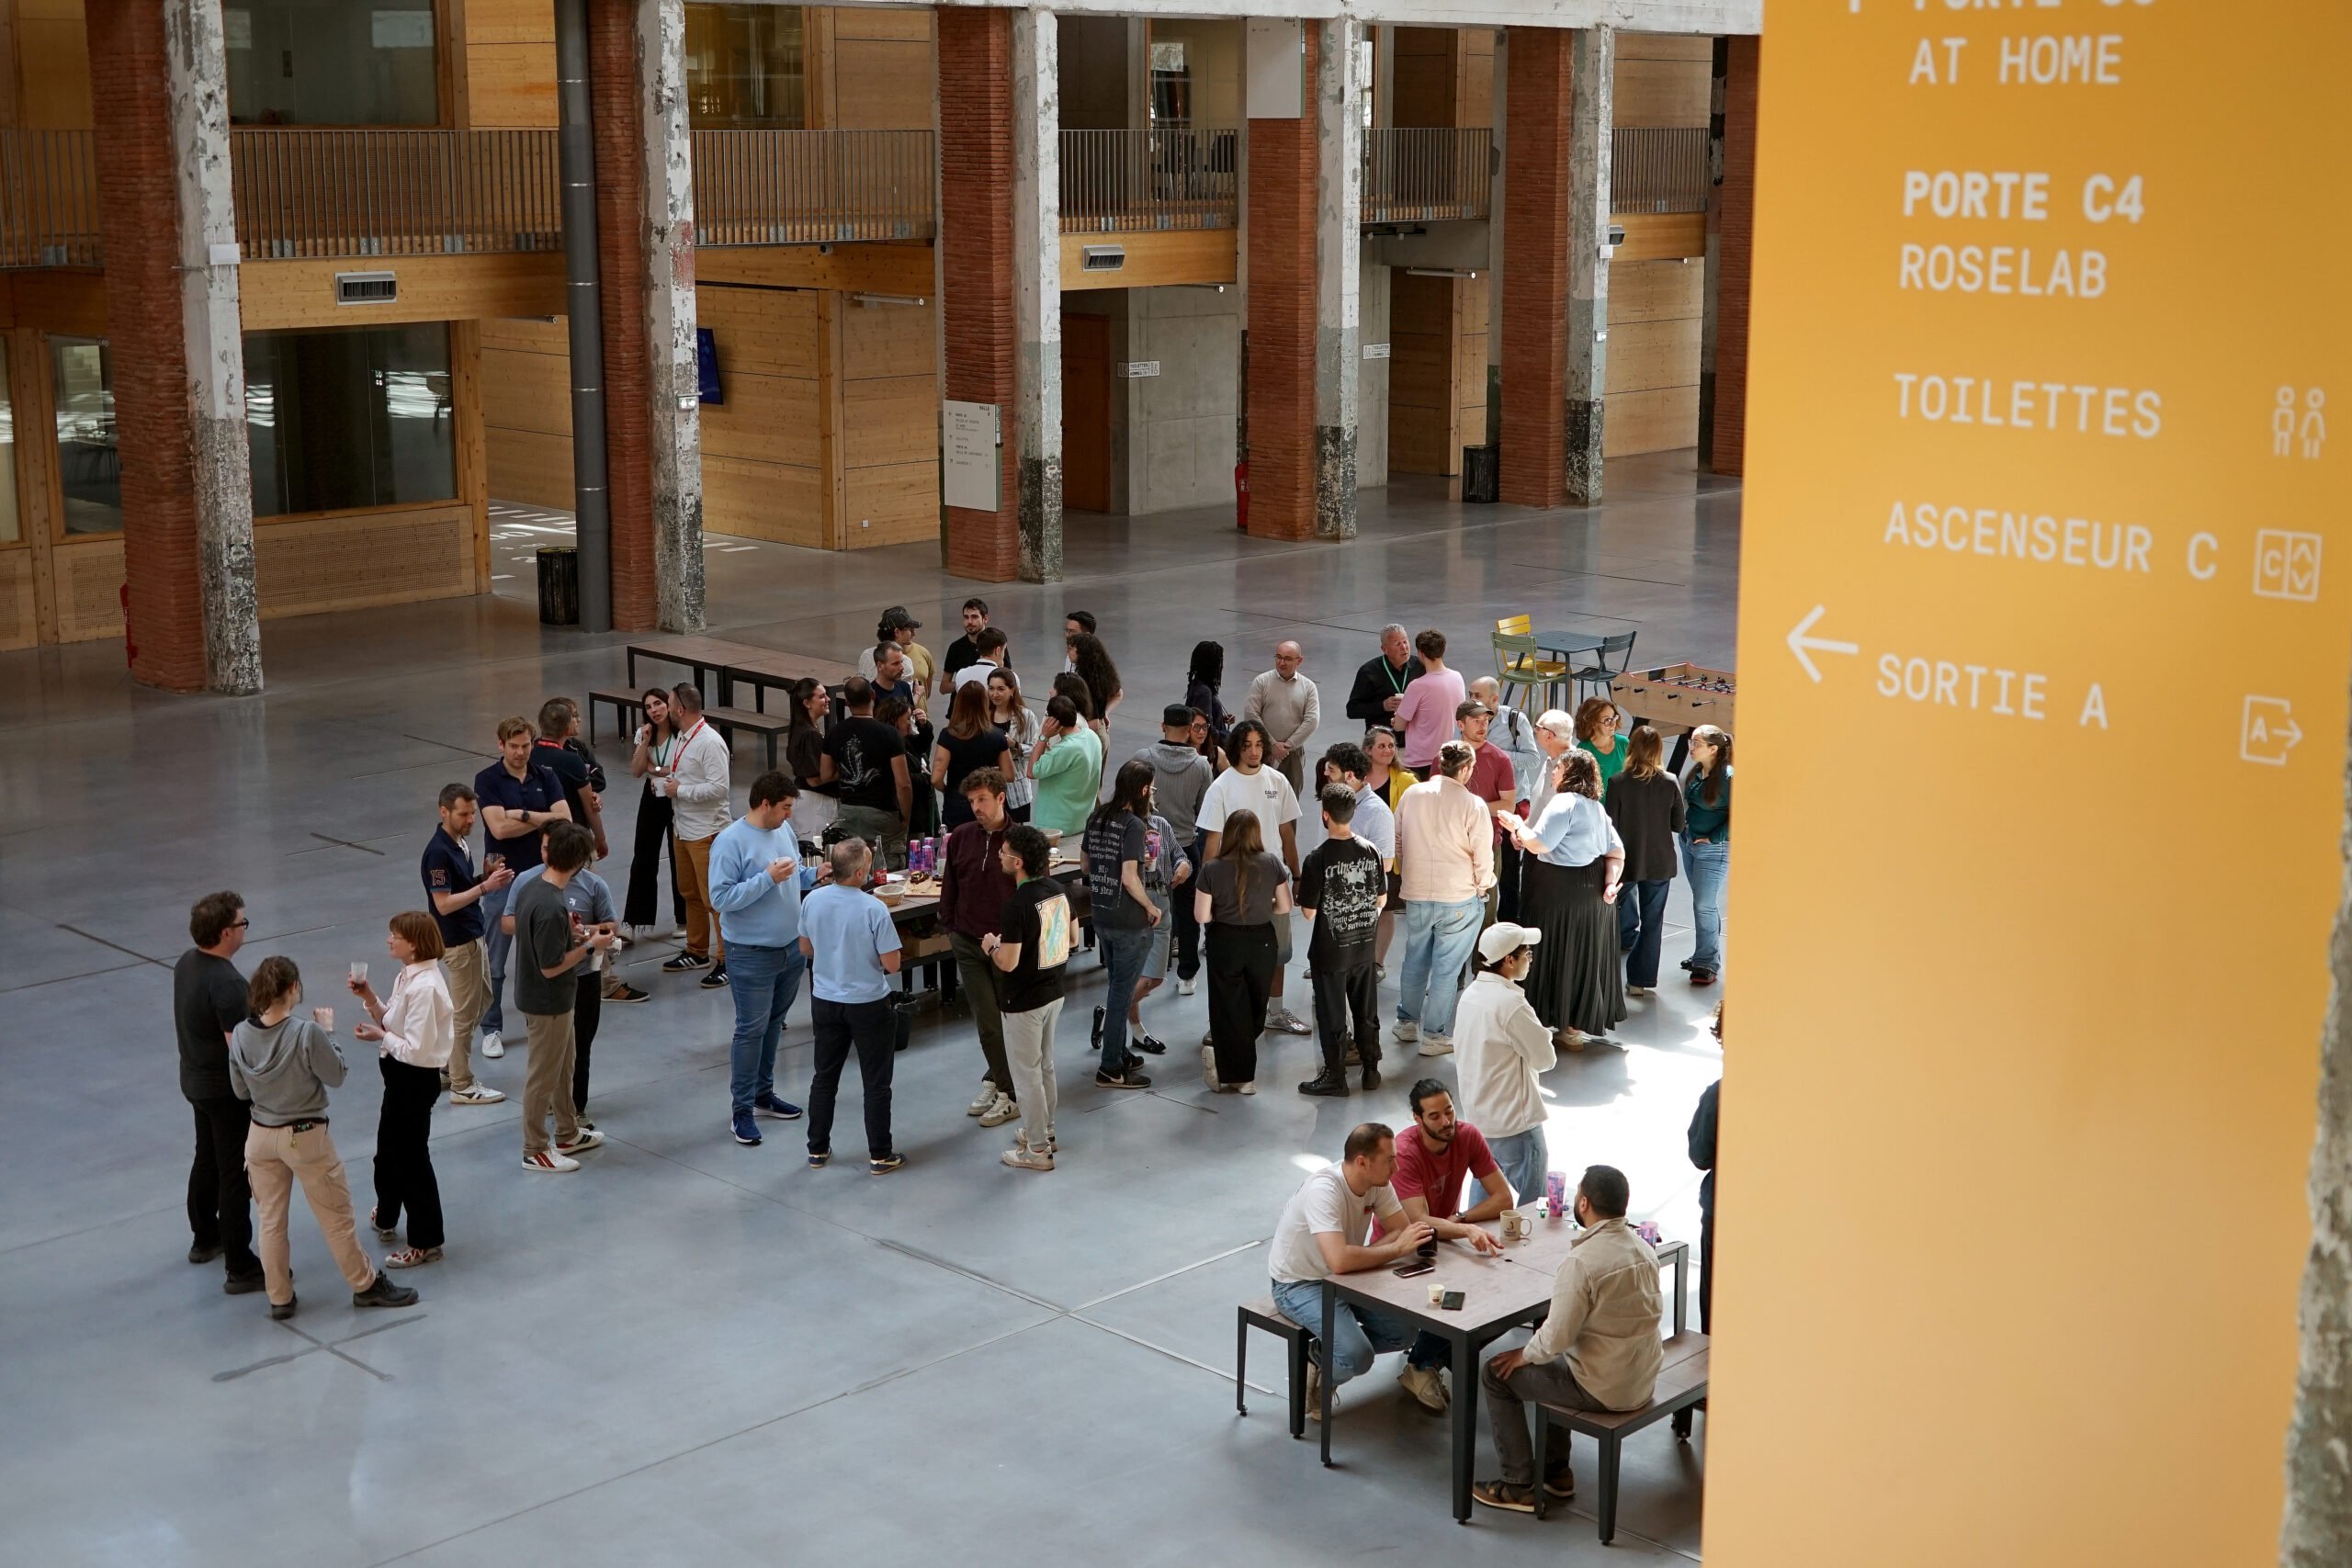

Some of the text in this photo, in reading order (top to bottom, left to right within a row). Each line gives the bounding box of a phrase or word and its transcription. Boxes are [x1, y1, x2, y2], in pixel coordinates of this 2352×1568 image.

[1909, 33, 2123, 85] AT HOME
[1903, 170, 2145, 223] PORTE C4
[1899, 243, 2108, 299] ROSELAB
[1894, 372, 2163, 438] TOILETTES
[1883, 501, 2219, 581] ASCENSEUR C
[2263, 549, 2283, 577] C
[1877, 653, 2109, 729] SORTIE A
[2250, 716, 2268, 744] A
[430, 869, 446, 886] 15
